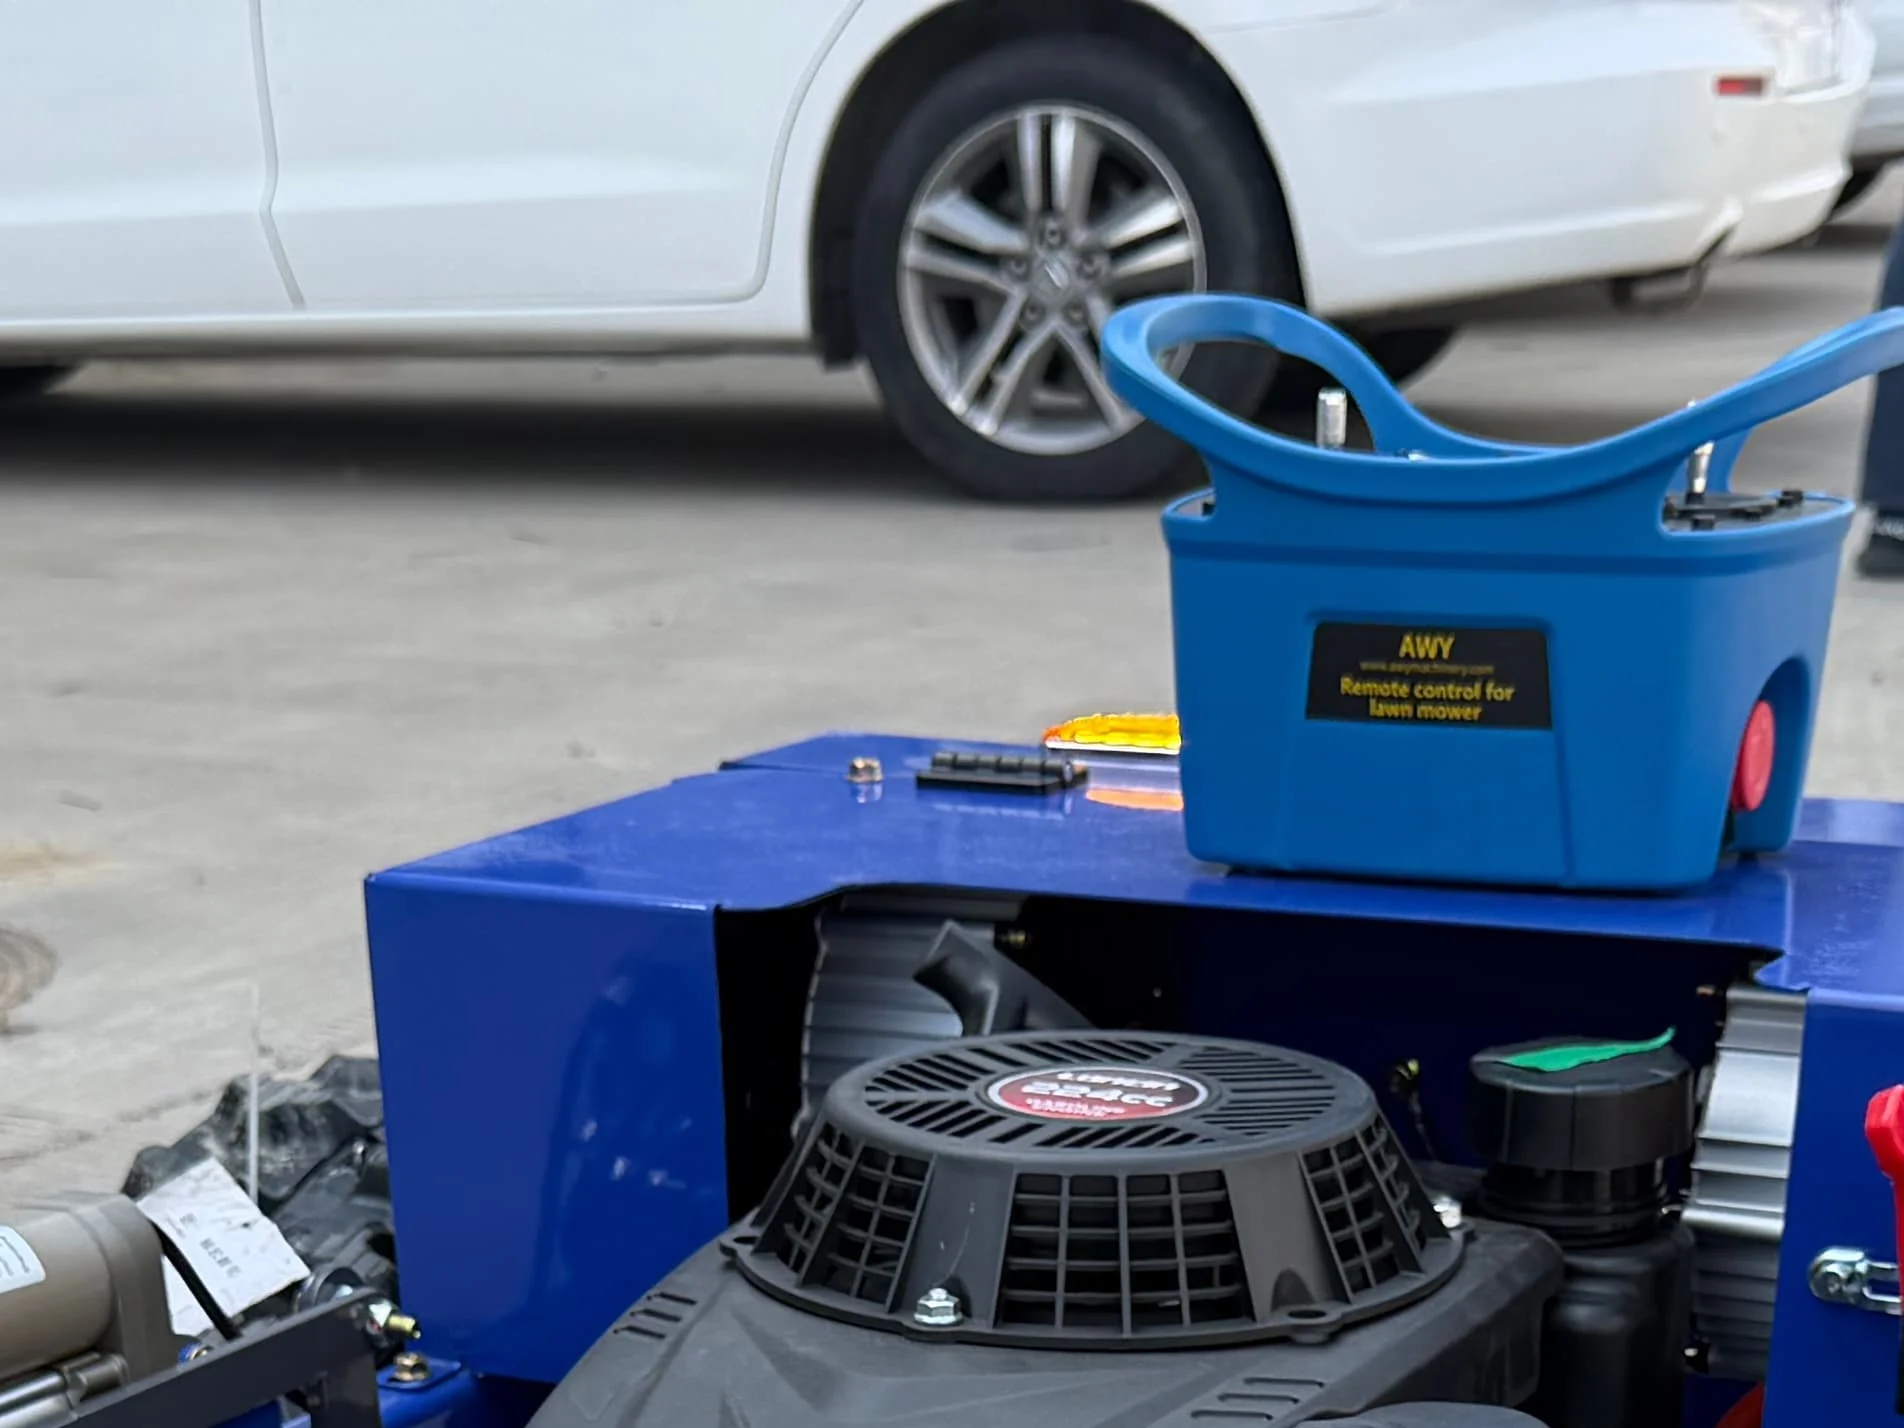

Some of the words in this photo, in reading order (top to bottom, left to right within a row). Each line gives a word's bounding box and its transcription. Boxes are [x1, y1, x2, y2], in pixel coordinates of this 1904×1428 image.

[1399, 633, 1455, 660] AWY
[1340, 674, 1410, 698] Remote
[1413, 679, 1482, 701] control
[1485, 682, 1516, 702] for
[1369, 698, 1414, 719] lawn
[1416, 702, 1482, 722] mower
